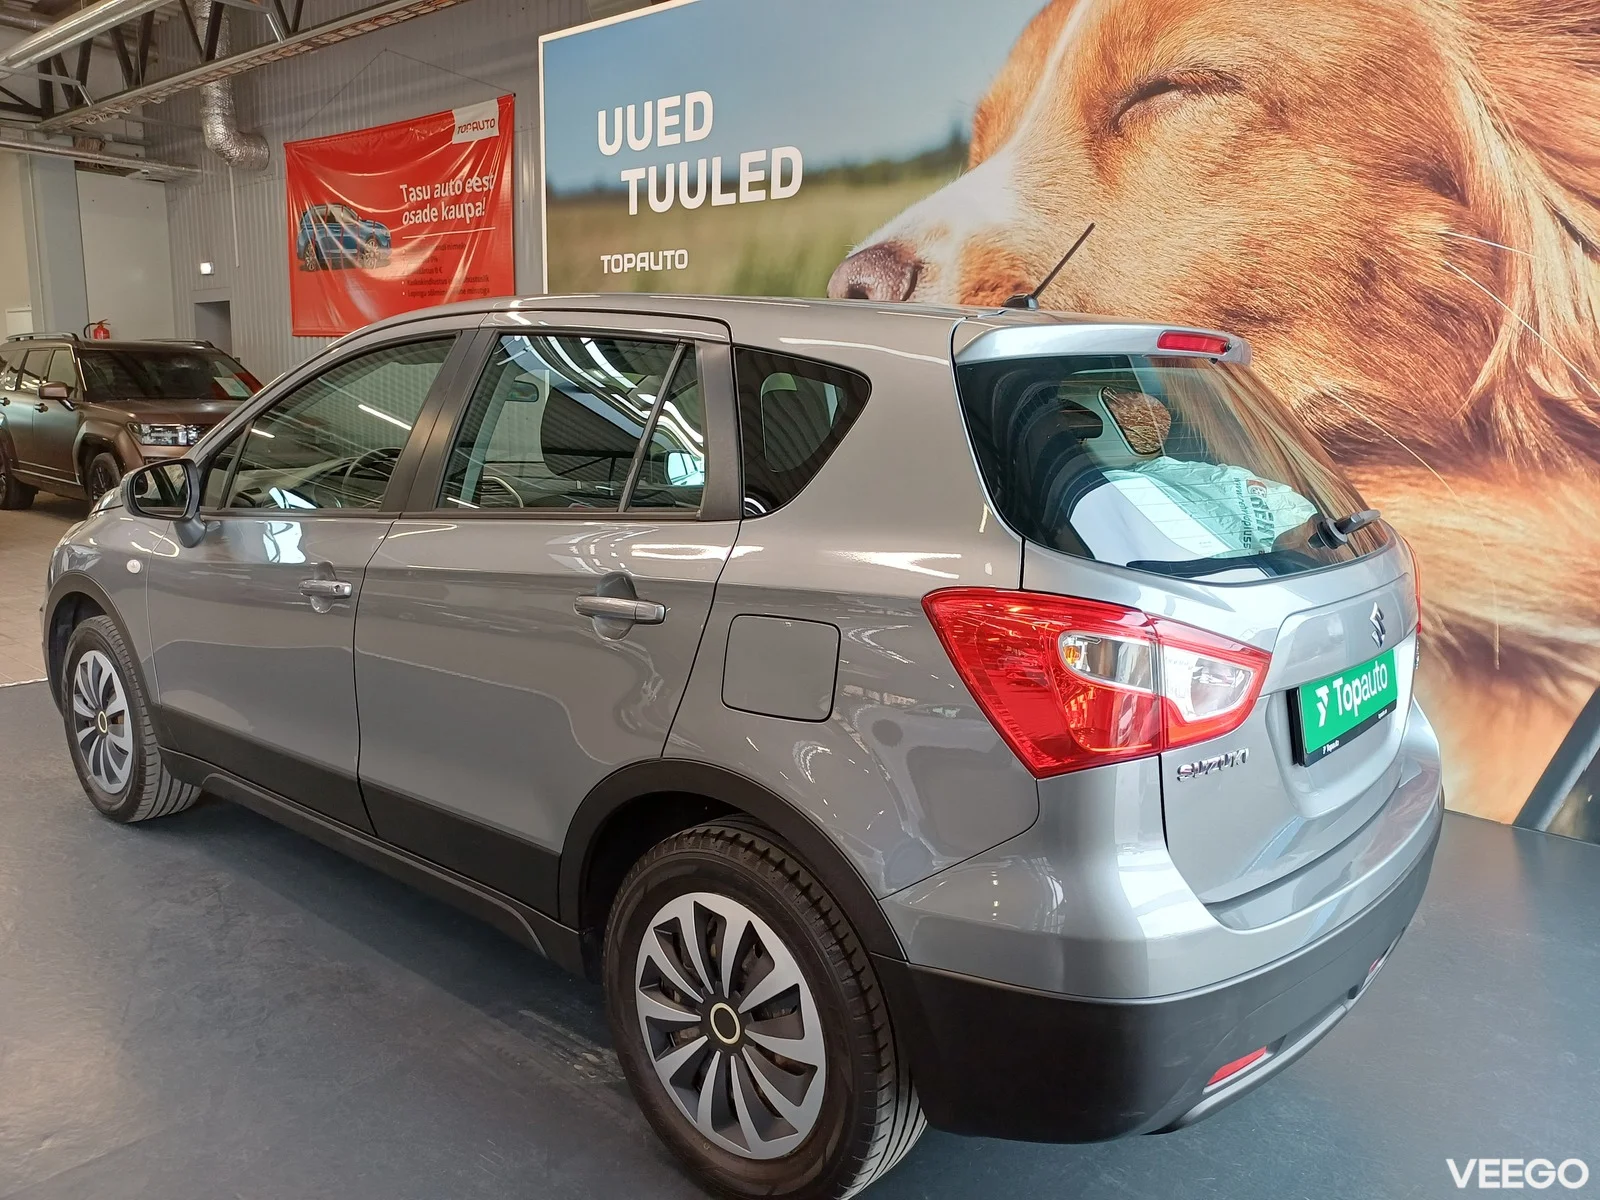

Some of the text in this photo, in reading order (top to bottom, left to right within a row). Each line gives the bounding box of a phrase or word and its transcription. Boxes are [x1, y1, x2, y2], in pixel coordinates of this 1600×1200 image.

[457, 118, 496, 135] TOPAUTO
[597, 90, 714, 156] UUED
[400, 173, 495, 204] Tasu auto eest
[621, 145, 803, 216] TUULED
[402, 196, 486, 226] osade kaupa!
[600, 249, 689, 274] TOPAUTO
[1333, 660, 1388, 717] Topauto
[1176, 747, 1250, 783] SUZUKI
